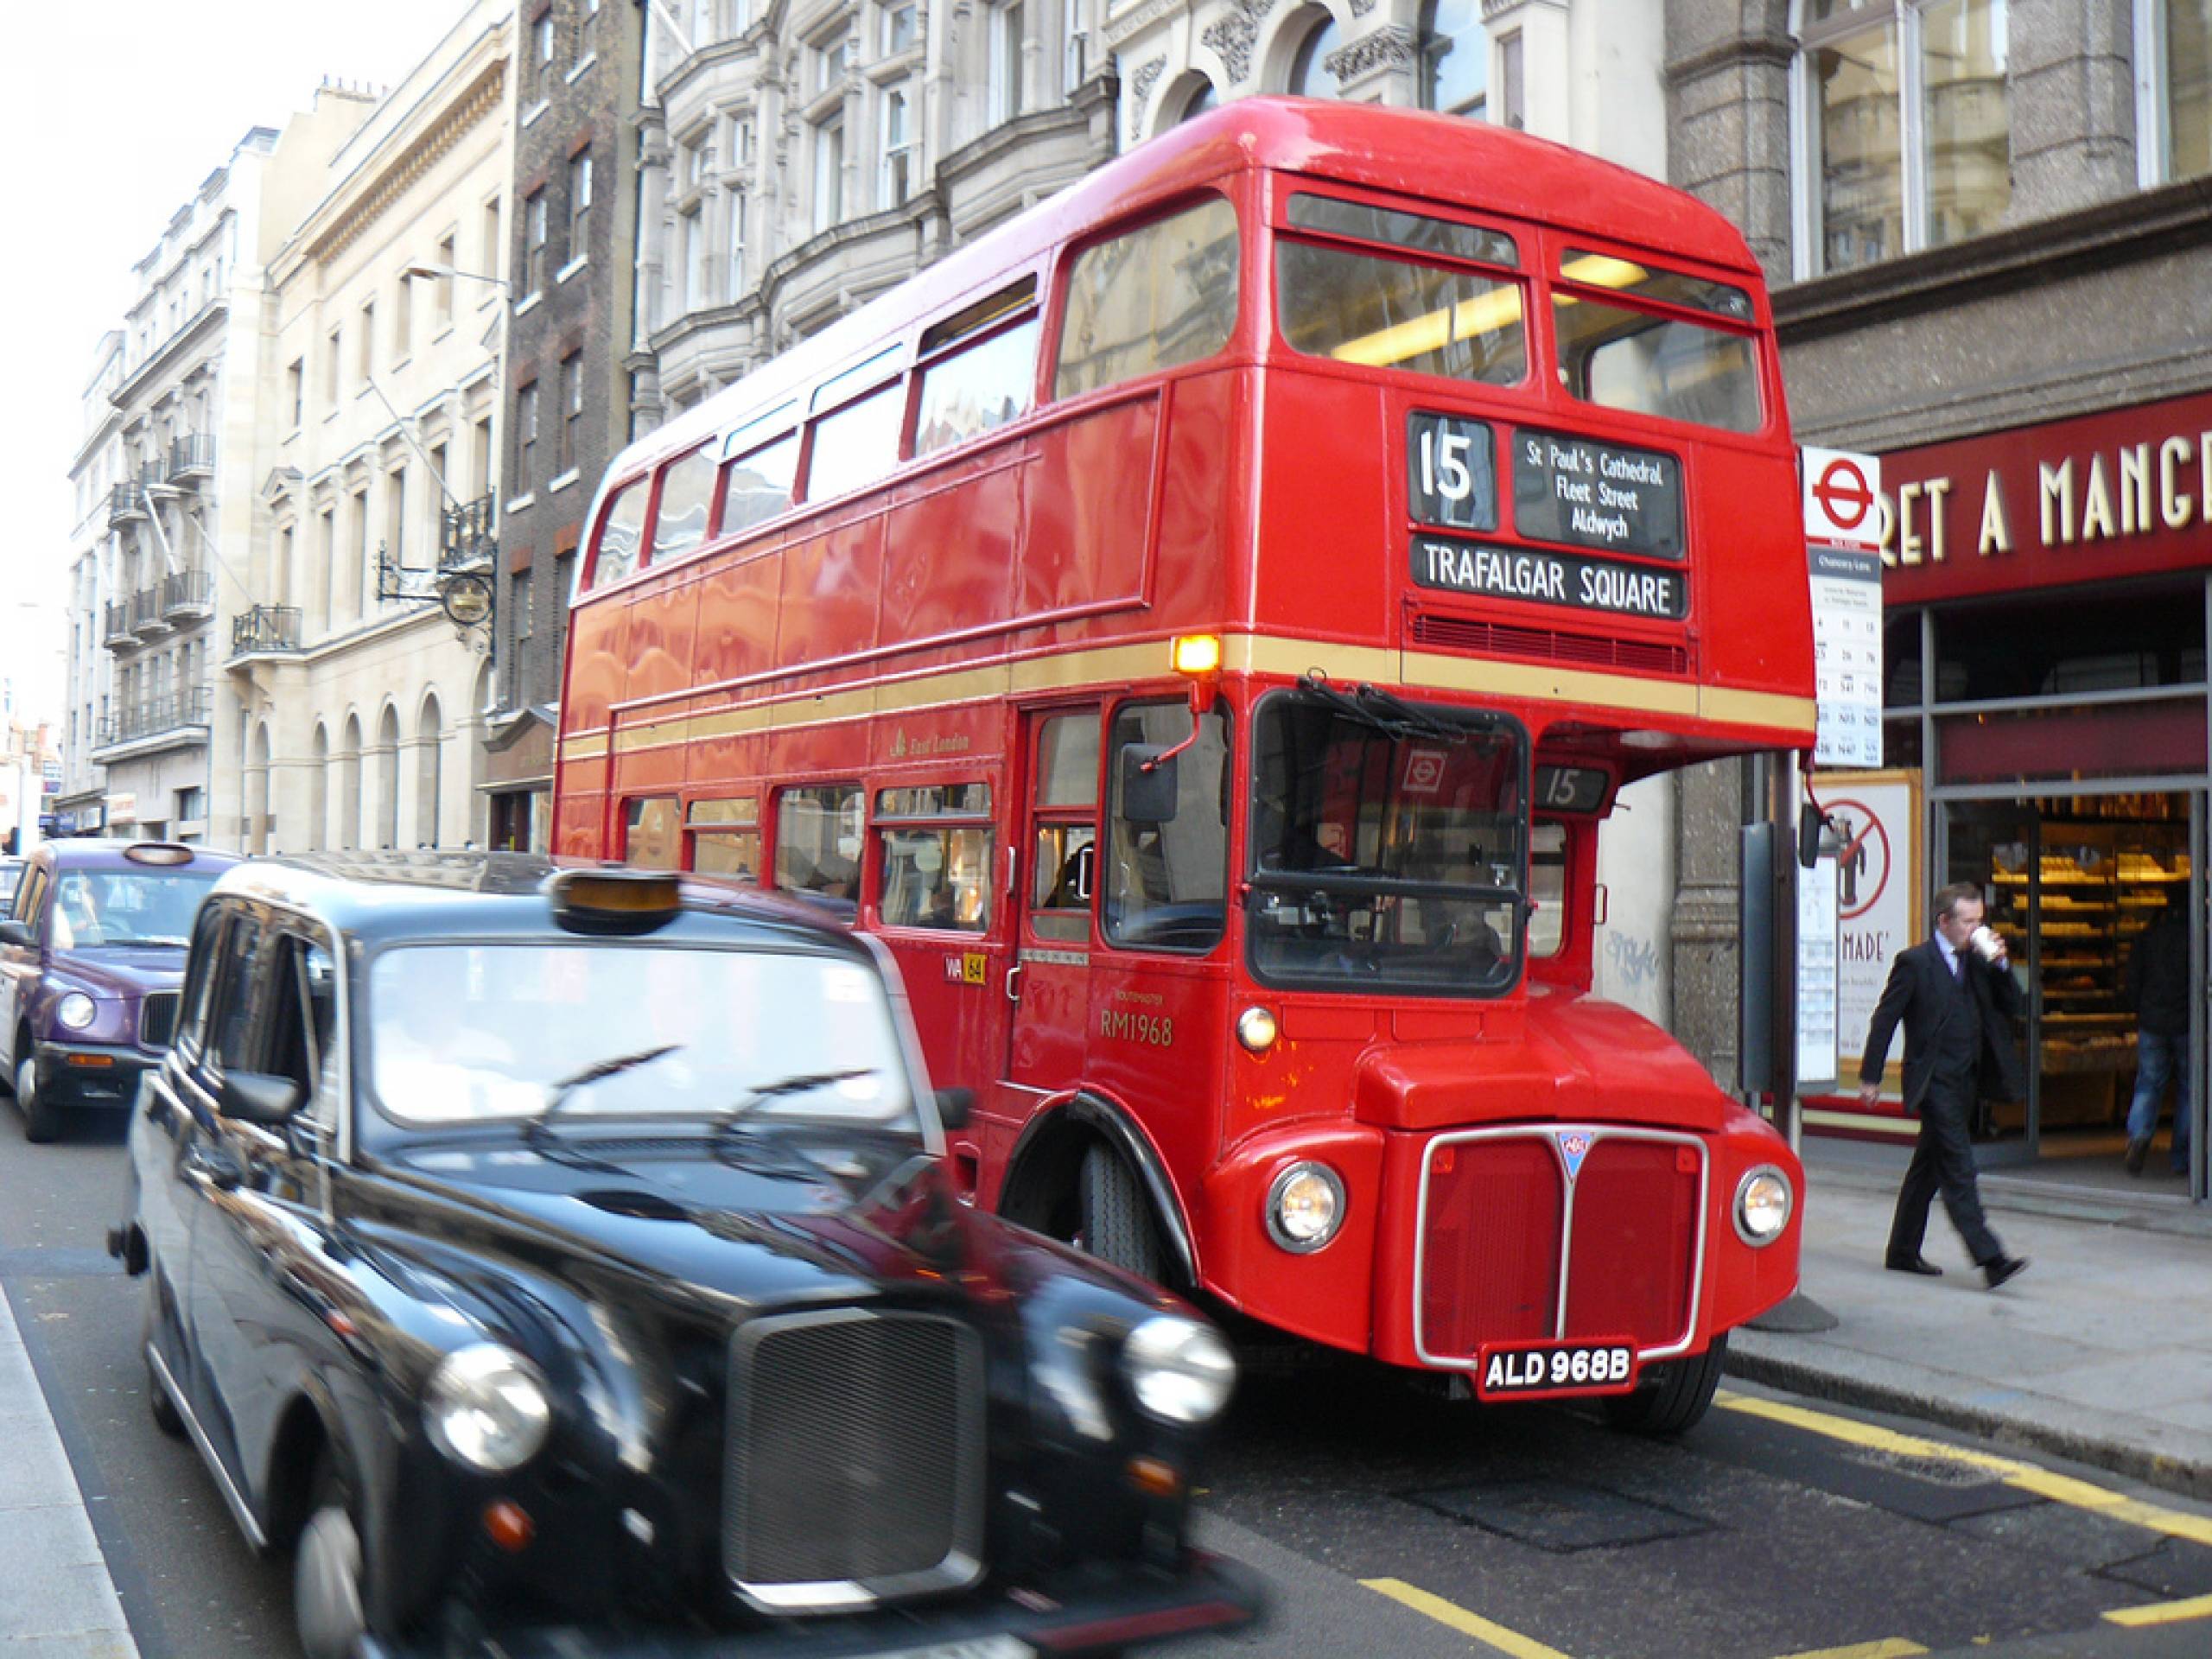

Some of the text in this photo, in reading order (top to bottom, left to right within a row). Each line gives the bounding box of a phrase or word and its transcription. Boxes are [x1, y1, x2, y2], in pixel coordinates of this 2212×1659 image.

[1421, 430, 1471, 499] 15
[1526, 440, 1664, 486] St Paul's Cathedral
[1556, 475, 1639, 512] Fleet Street
[1978, 469, 2014, 556] A
[1572, 506, 1630, 543] Aldwych
[1423, 543, 1671, 614] TRAFALGAR SQUARE
[1547, 768, 1576, 804] 15
[967, 958, 982, 979] 64
[1100, 1008, 1173, 1046] RM1968
[1484, 1347, 1630, 1388] ALD 968B
